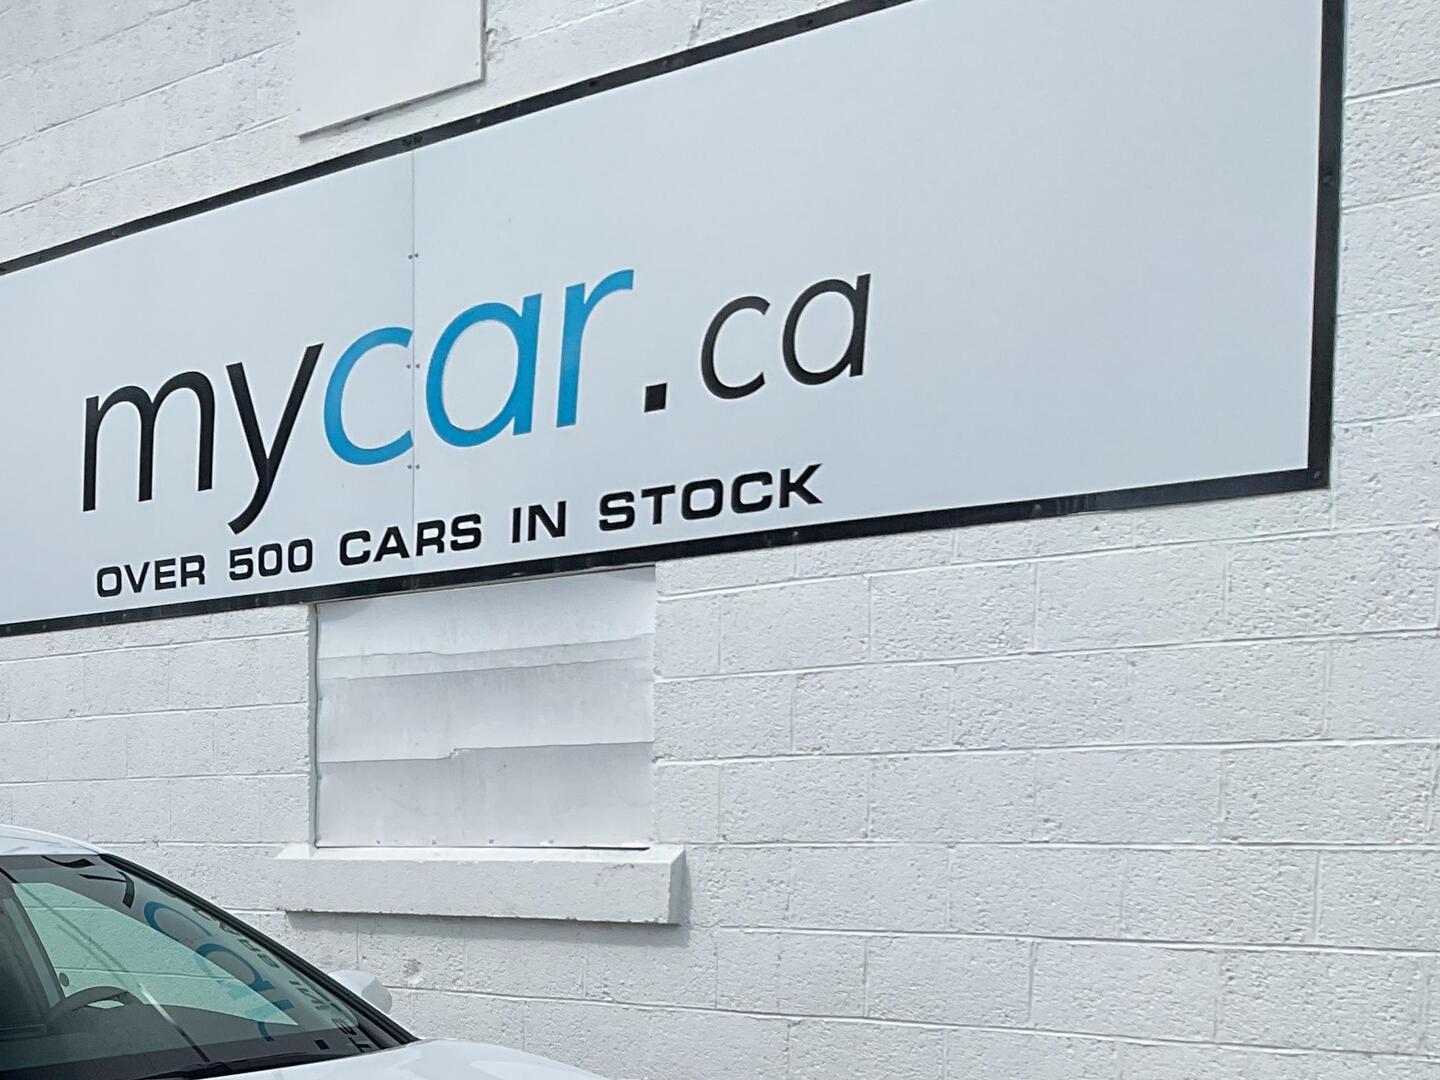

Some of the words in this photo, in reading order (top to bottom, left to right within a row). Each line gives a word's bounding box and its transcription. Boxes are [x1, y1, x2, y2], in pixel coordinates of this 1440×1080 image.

[81, 269, 871, 533] mycar.ca
[96, 554, 206, 598] OVER
[228, 538, 313, 581] 500
[339, 513, 482, 567] CARS
[511, 500, 567, 544] IN
[598, 463, 823, 532] STOCK
